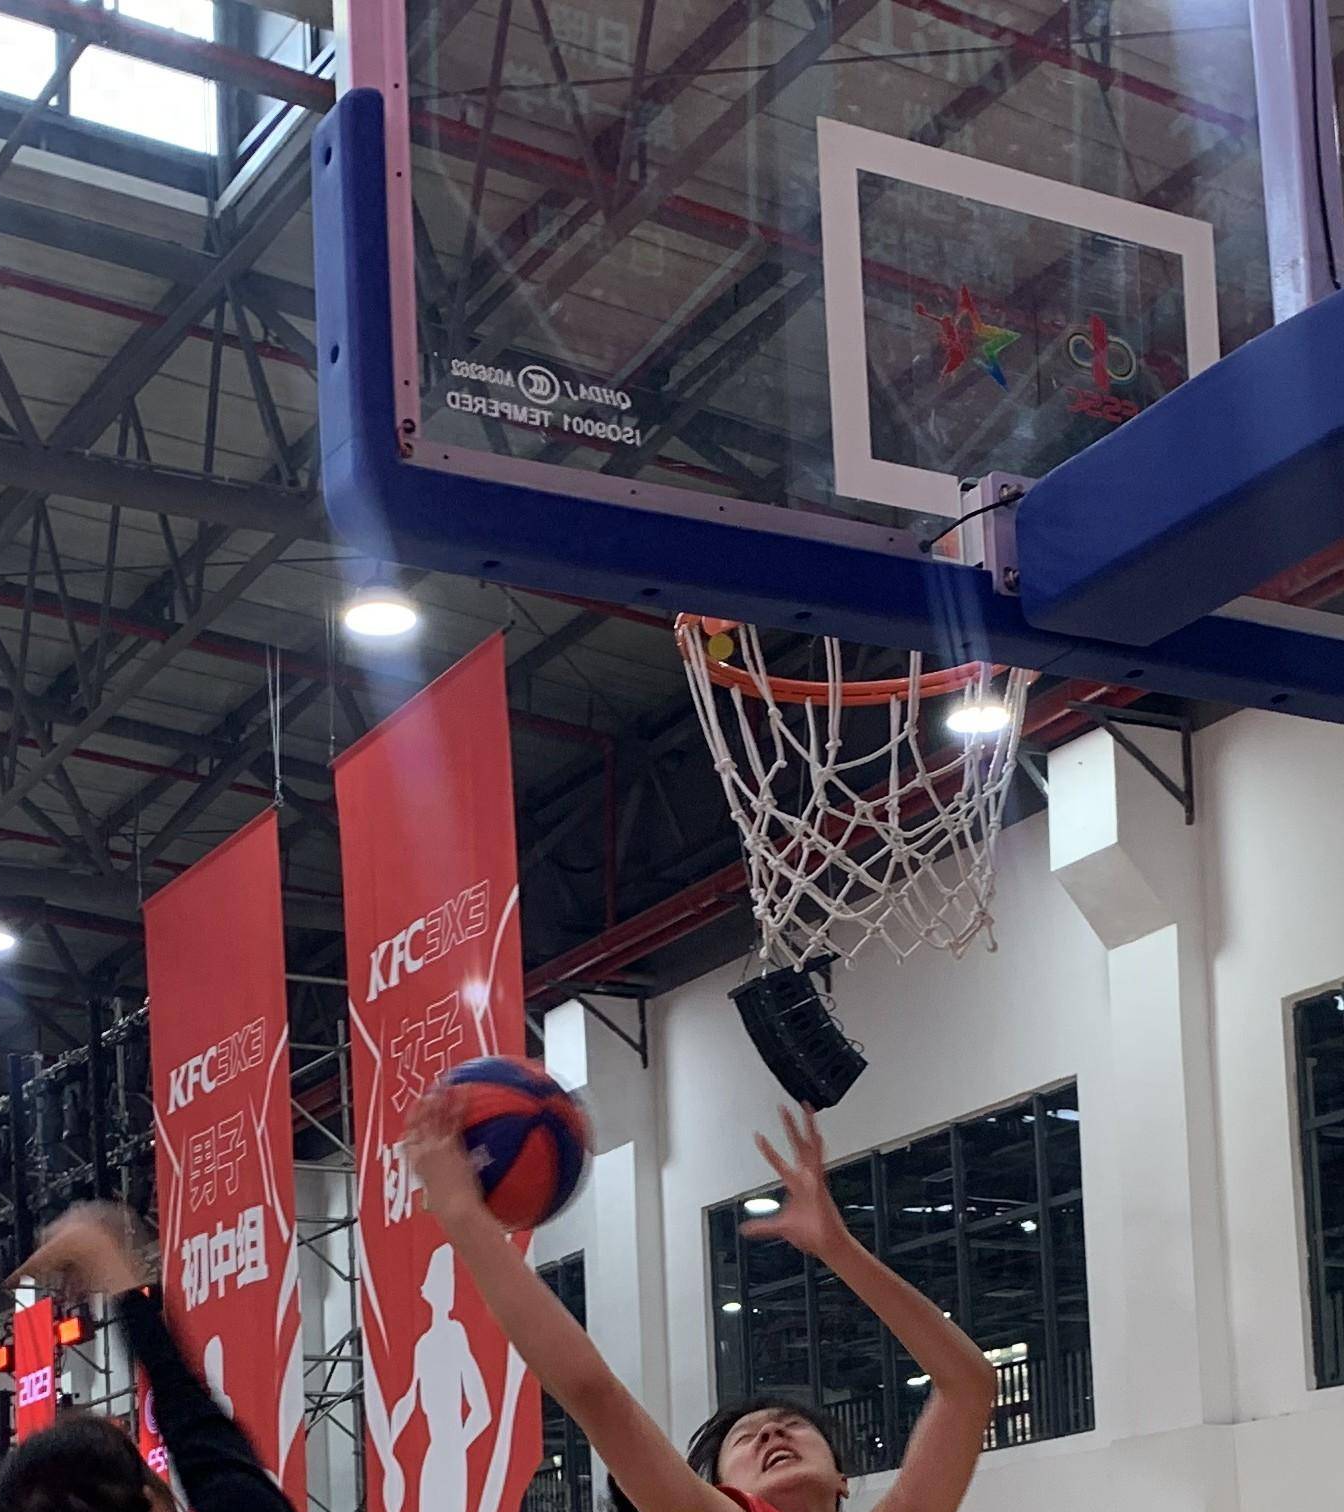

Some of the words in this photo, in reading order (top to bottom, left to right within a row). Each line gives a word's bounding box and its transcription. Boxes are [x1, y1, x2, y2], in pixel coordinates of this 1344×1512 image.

[189, 1110, 248, 1213] 男子
[181, 1204, 269, 1312] 初中组
[18, 1365, 53, 1408] 2023
